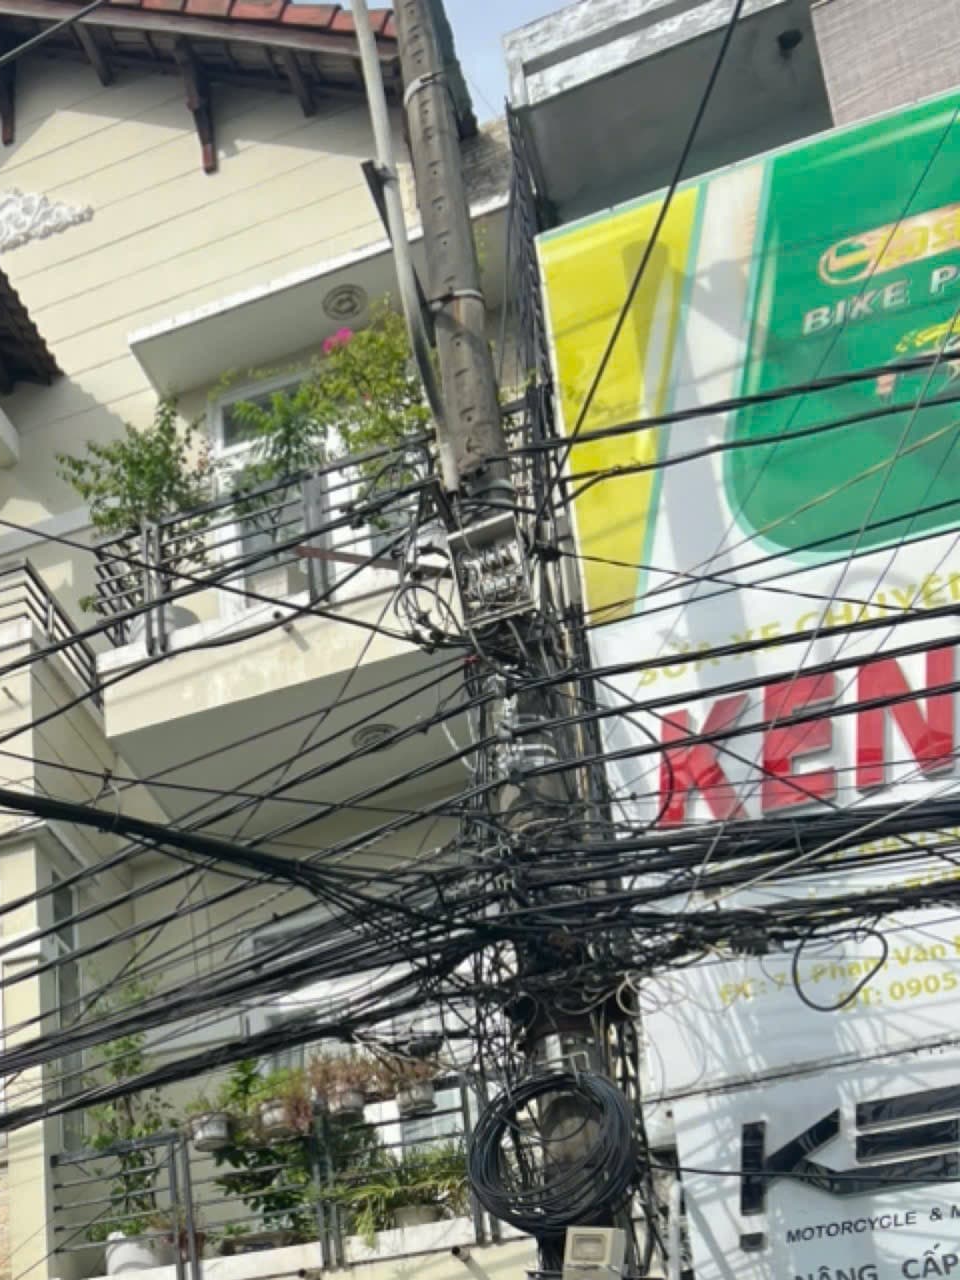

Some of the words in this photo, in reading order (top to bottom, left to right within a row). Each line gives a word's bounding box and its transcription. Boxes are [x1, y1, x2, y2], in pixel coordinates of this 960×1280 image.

[802, 280, 910, 335] BIKE
[889, 974, 958, 1001] 0905
[786, 1210, 918, 1243] MOTORCYCLE
[929, 1207, 943, 1221] &
[901, 1243, 959, 1280] CẤP
